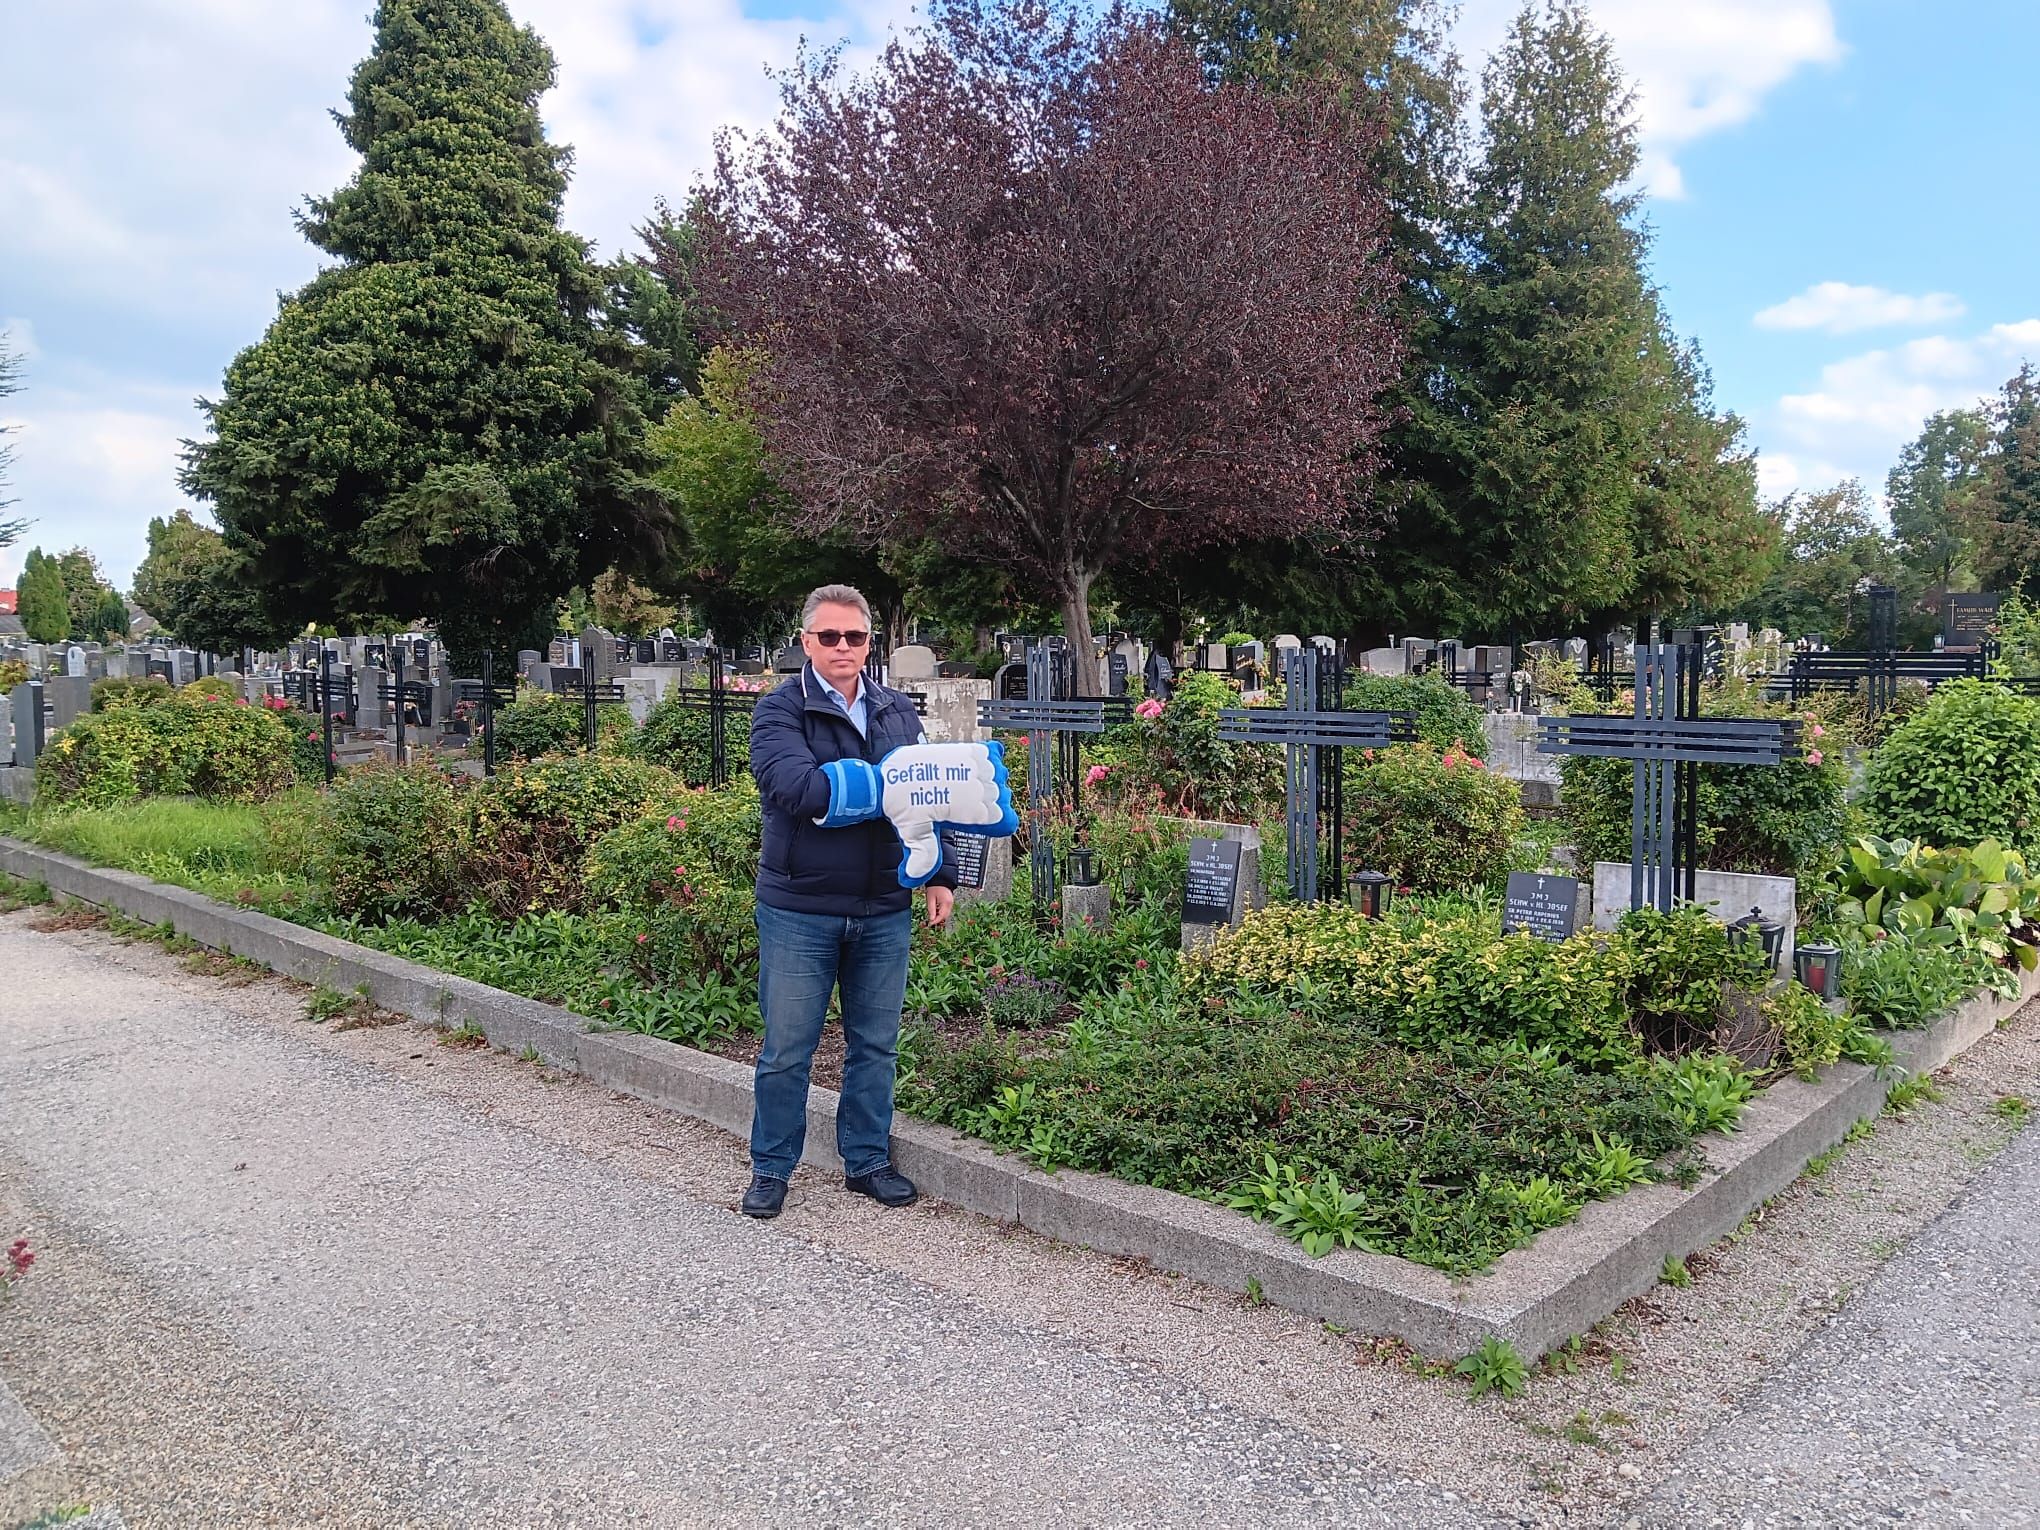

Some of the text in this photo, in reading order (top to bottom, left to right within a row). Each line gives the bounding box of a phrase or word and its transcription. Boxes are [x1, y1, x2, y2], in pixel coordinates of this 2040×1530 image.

[886, 762, 971, 784] Gefällt mir
[910, 786, 950, 806] nicht
[1547, 903, 1569, 912] JOSEF
